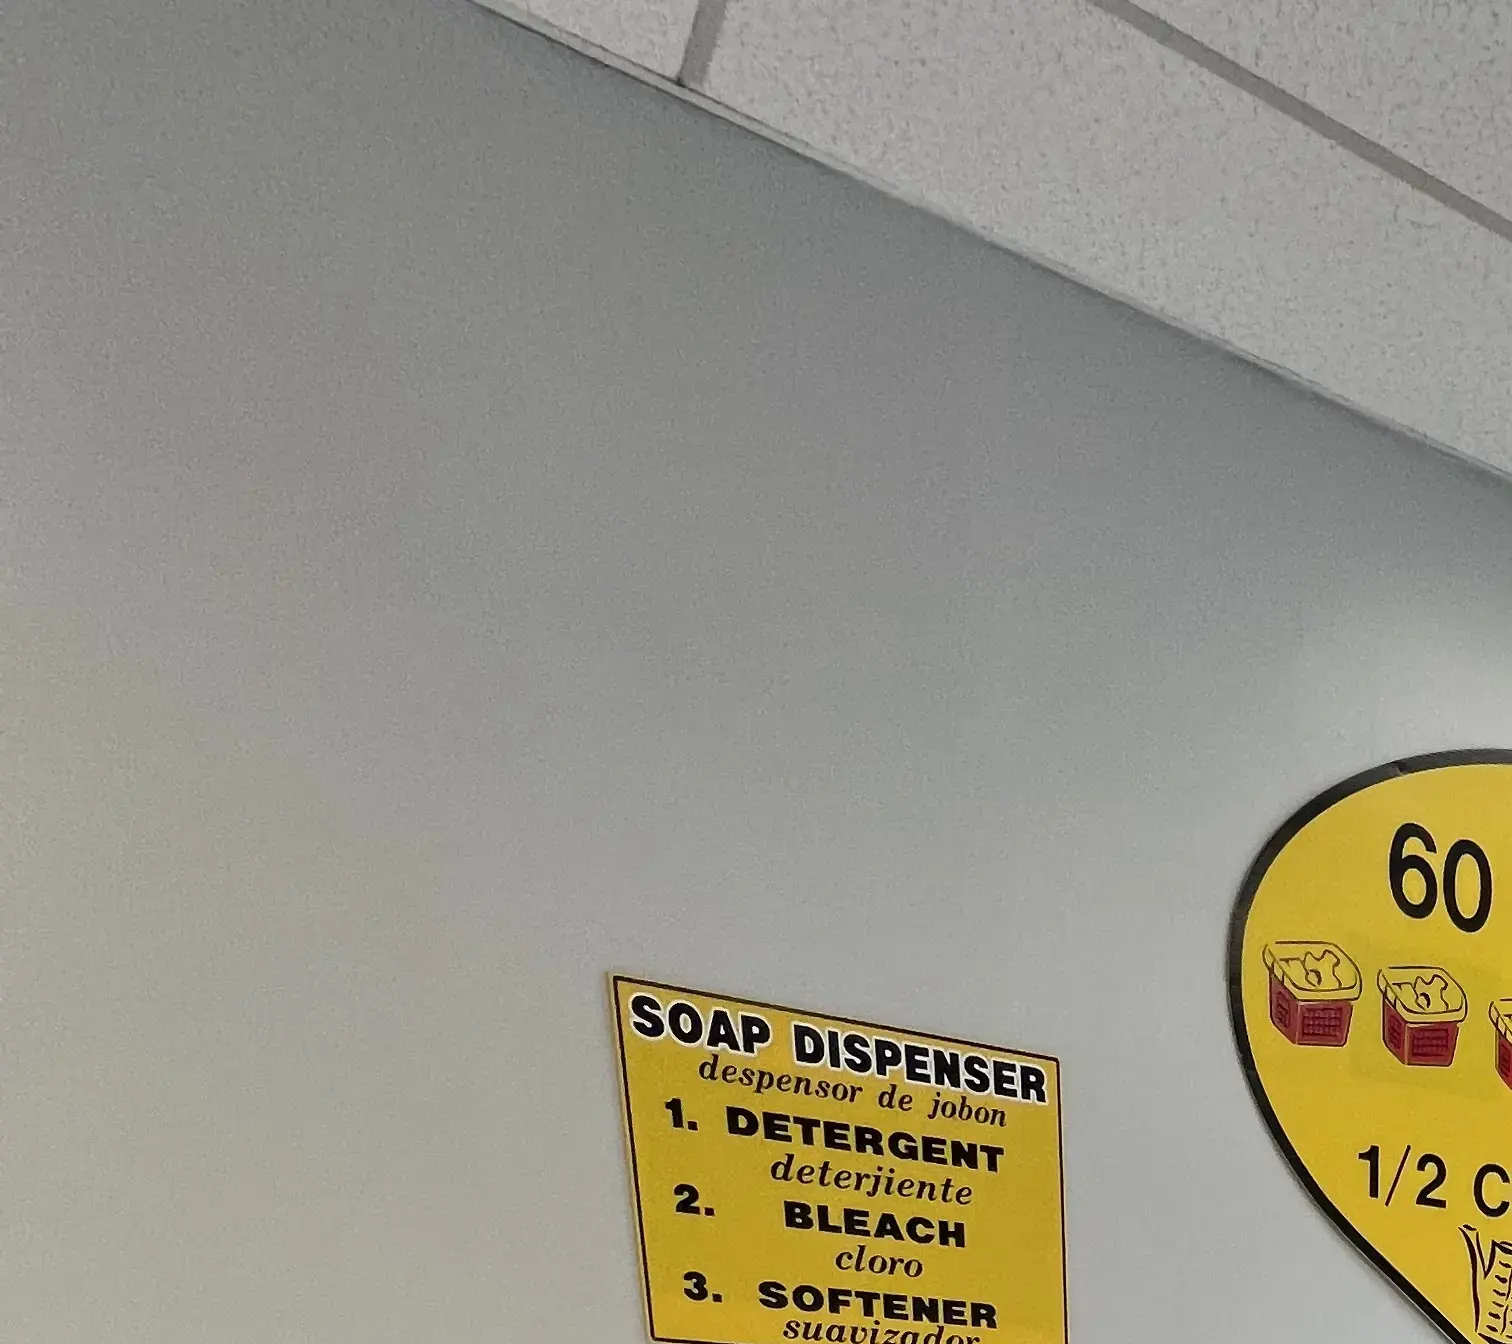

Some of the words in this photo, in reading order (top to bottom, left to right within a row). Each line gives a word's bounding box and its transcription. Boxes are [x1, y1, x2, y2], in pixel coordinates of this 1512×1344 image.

[1388, 821, 1491, 933] 60
[630, 994, 770, 1054] SOAP
[793, 1022, 1047, 1103] DISPENSER
[699, 1054, 863, 1104] despensor
[878, 1083, 913, 1112] de
[926, 1092, 1007, 1127] jobon
[664, 1098, 698, 1132] 1.
[726, 1106, 1004, 1172] DETERGENT
[770, 1153, 974, 1205] deterjiente
[1357, 1144, 1447, 1209] 1/2
[673, 1183, 715, 1217] 2.
[783, 1200, 966, 1248] BLEACH
[835, 1245, 924, 1278] cloro
[683, 1271, 723, 1303] 3.
[757, 1281, 998, 1329] SOFTENER
